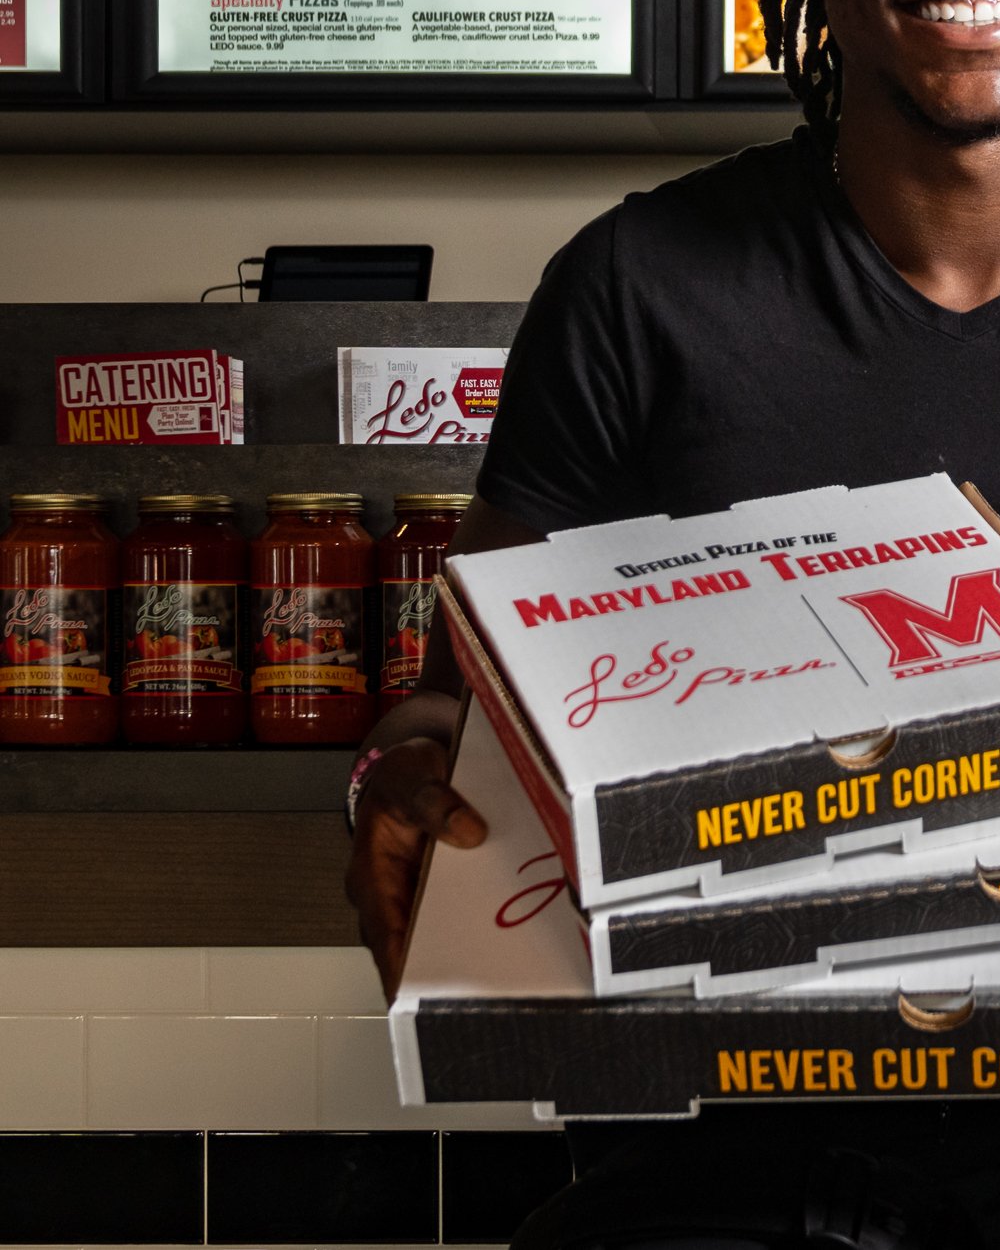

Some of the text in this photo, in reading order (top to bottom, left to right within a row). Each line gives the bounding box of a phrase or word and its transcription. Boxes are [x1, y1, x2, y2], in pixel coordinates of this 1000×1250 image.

[210, 11, 348, 23] GLUTEN-FREE CRUST PIZZA
[412, 11, 555, 23] CAULIFLOWER CRUST PIZZA
[61, 358, 210, 407] CATERING
[387, 360, 418, 374] family
[460, 379, 499, 388] FAST. EASY.
[67, 407, 140, 443] MENU
[366, 377, 447, 444] Ledo
[513, 525, 988, 628] MARYLAND TERRAPINS
[564, 640, 695, 729] Ledo
[697, 792, 805, 851] NEVER
[816, 775, 884, 824] CUT
[717, 1049, 857, 1092] NEVER
[873, 1047, 955, 1090] CUT
